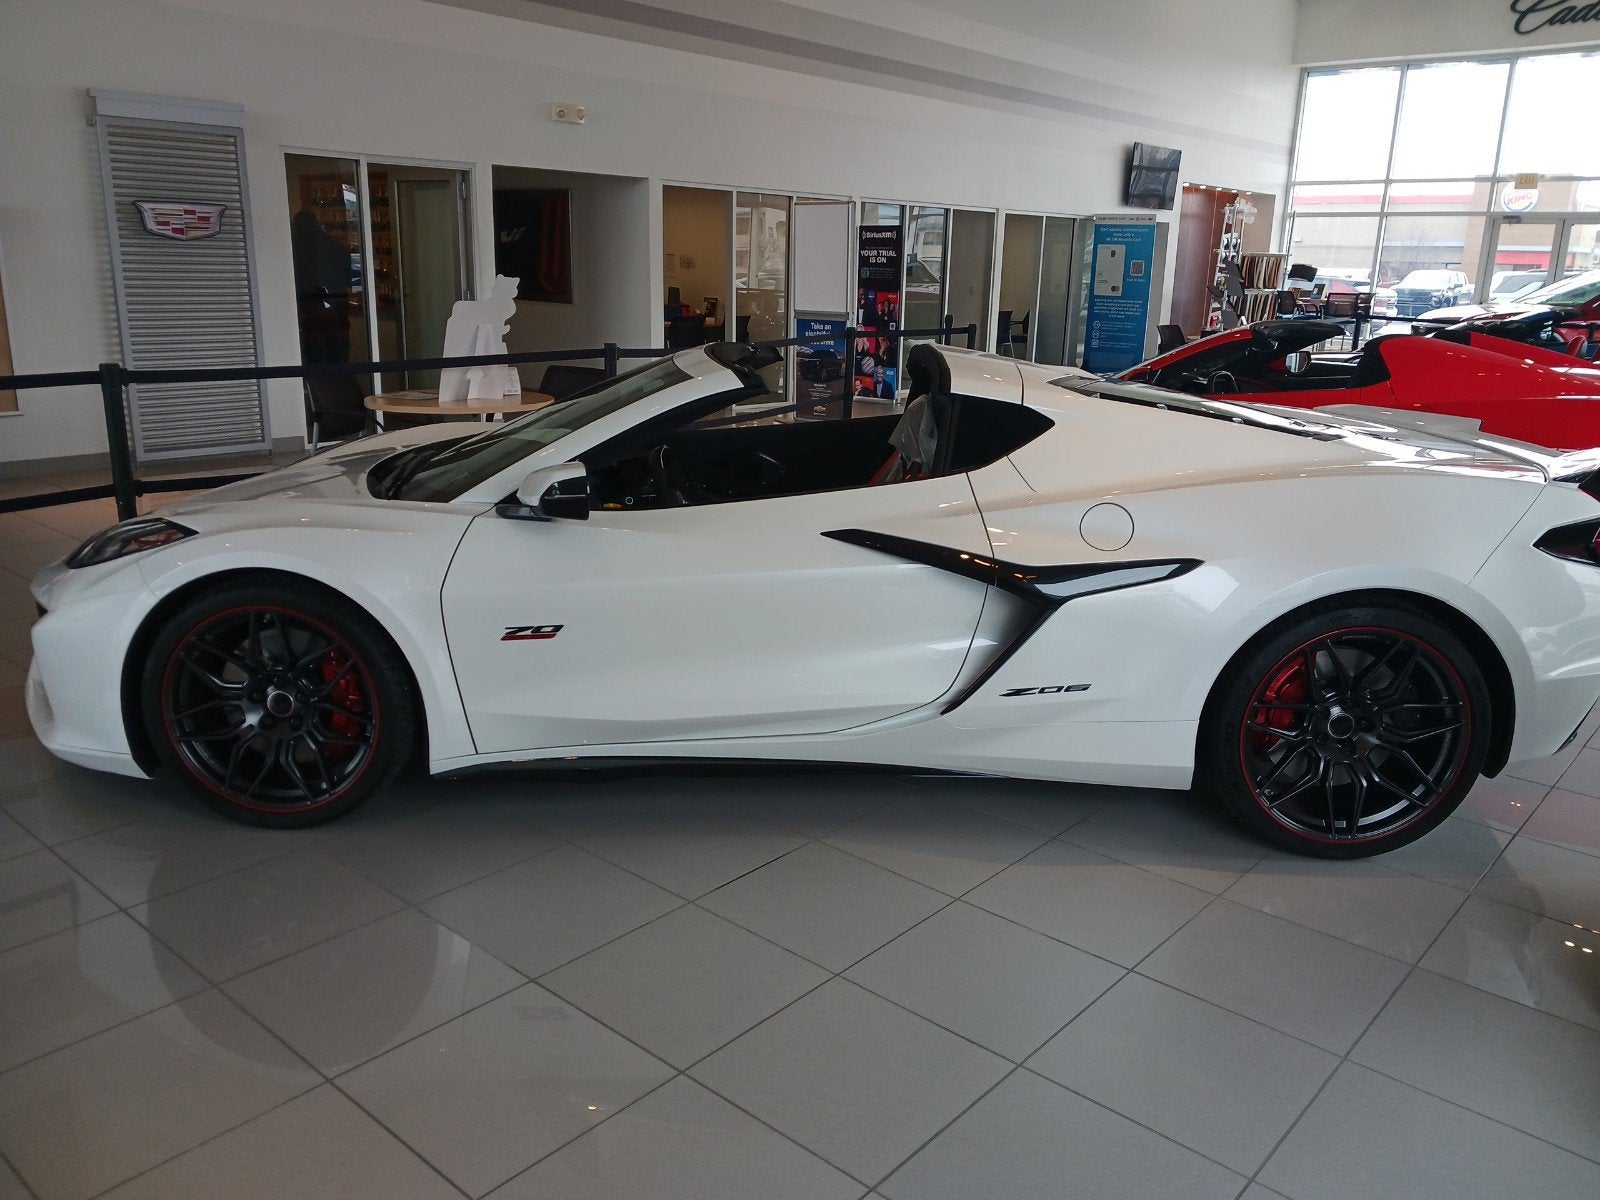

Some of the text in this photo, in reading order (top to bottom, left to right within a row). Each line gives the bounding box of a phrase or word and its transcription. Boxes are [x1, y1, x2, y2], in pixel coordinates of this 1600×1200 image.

[1506, 192, 1533, 206] KING
[869, 256, 887, 264] IS ON
[810, 322, 824, 330] Take
[999, 684, 1092, 697] Z06
